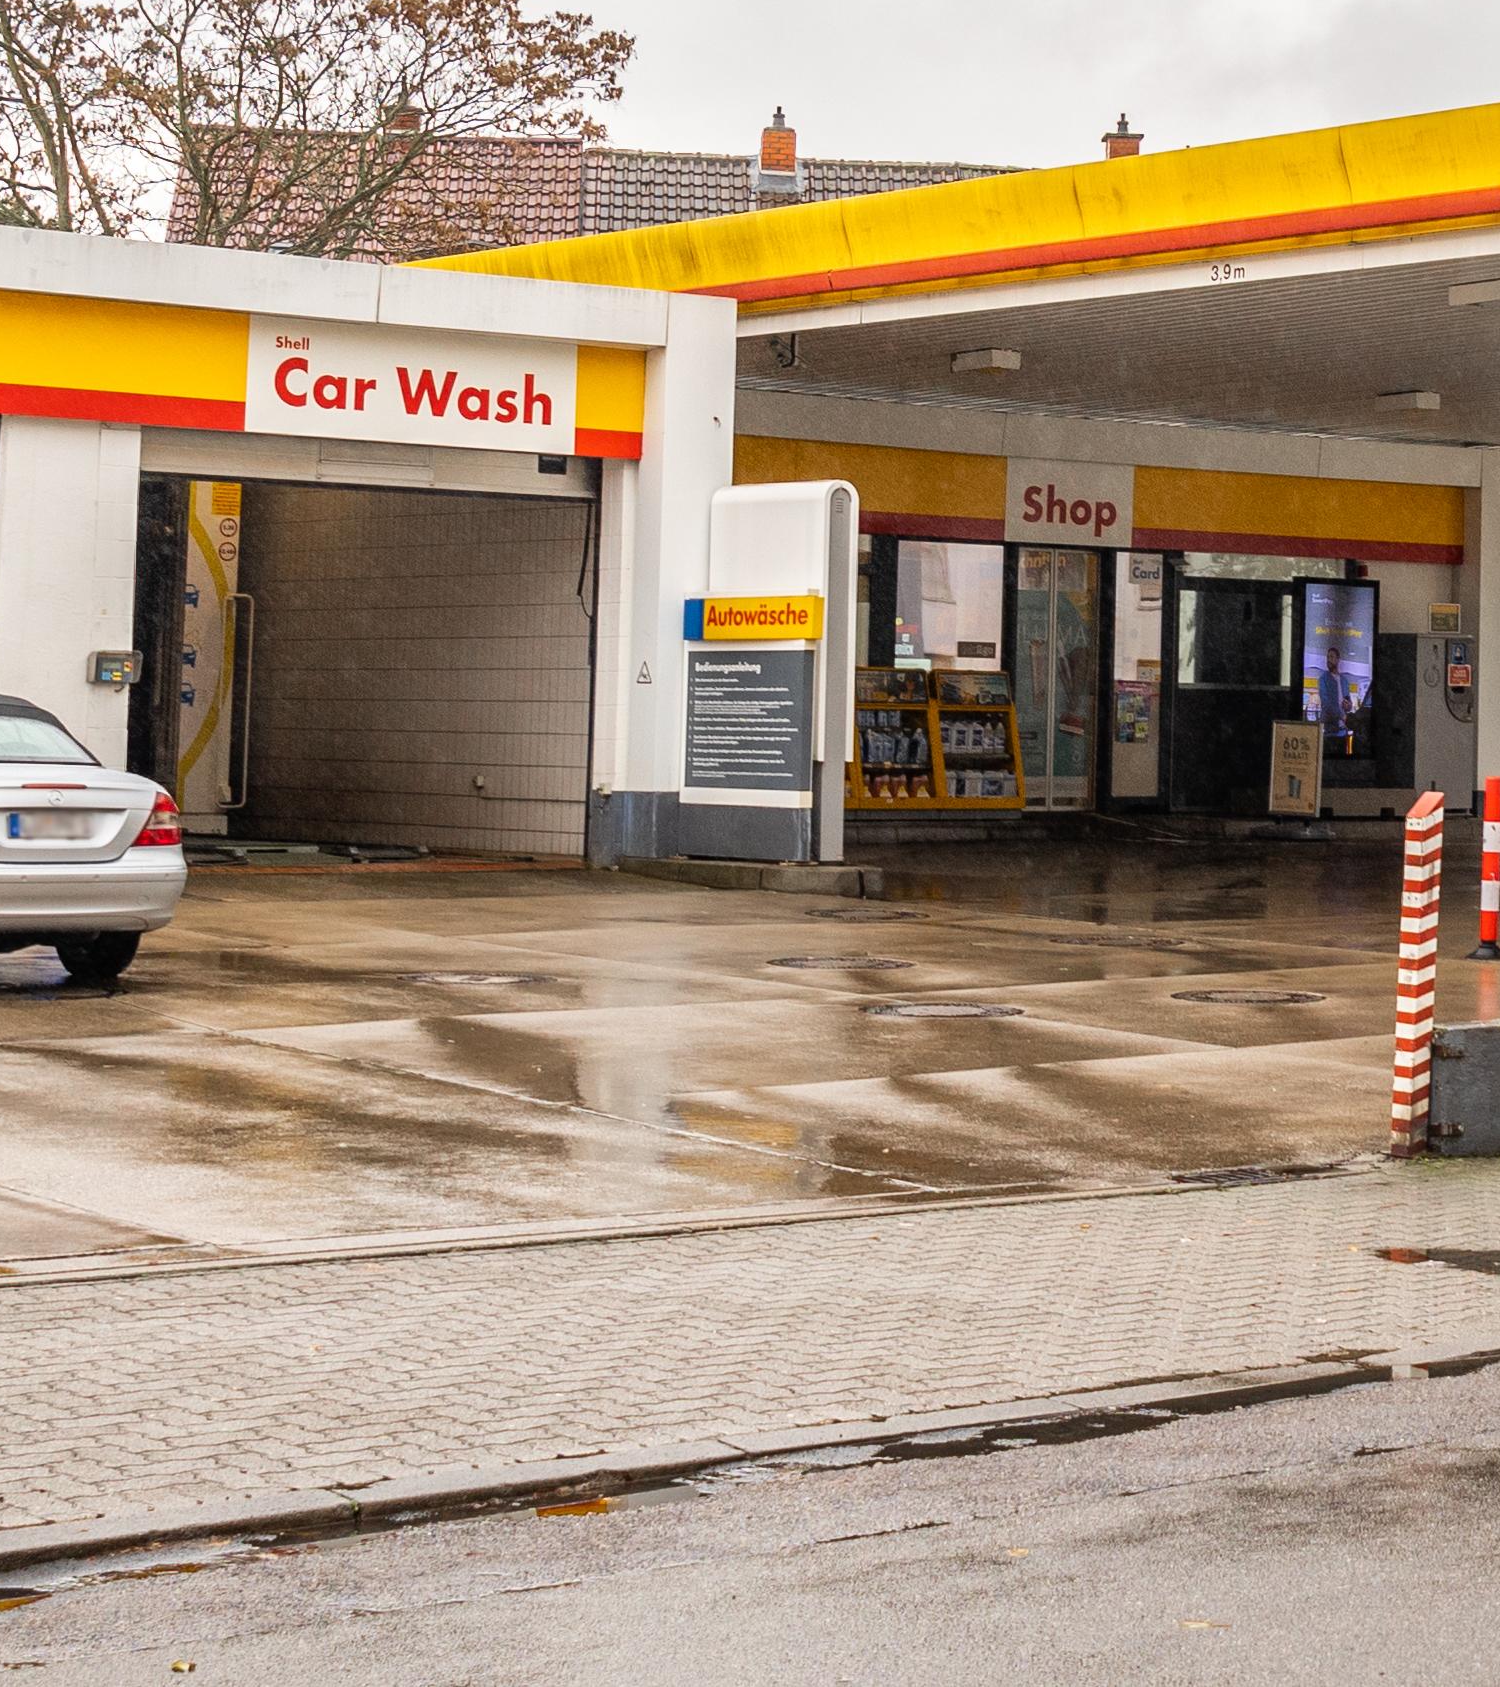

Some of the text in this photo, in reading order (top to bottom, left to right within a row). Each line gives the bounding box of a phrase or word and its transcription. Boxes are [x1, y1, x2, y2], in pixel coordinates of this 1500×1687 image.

[1210, 263, 1246, 282] 3,9 m
[275, 335, 310, 351] Shell
[274, 357, 553, 426] Car Wash
[1022, 484, 1117, 538] Shop
[1132, 566, 1161, 580] Card
[706, 602, 809, 627] Autowäsche
